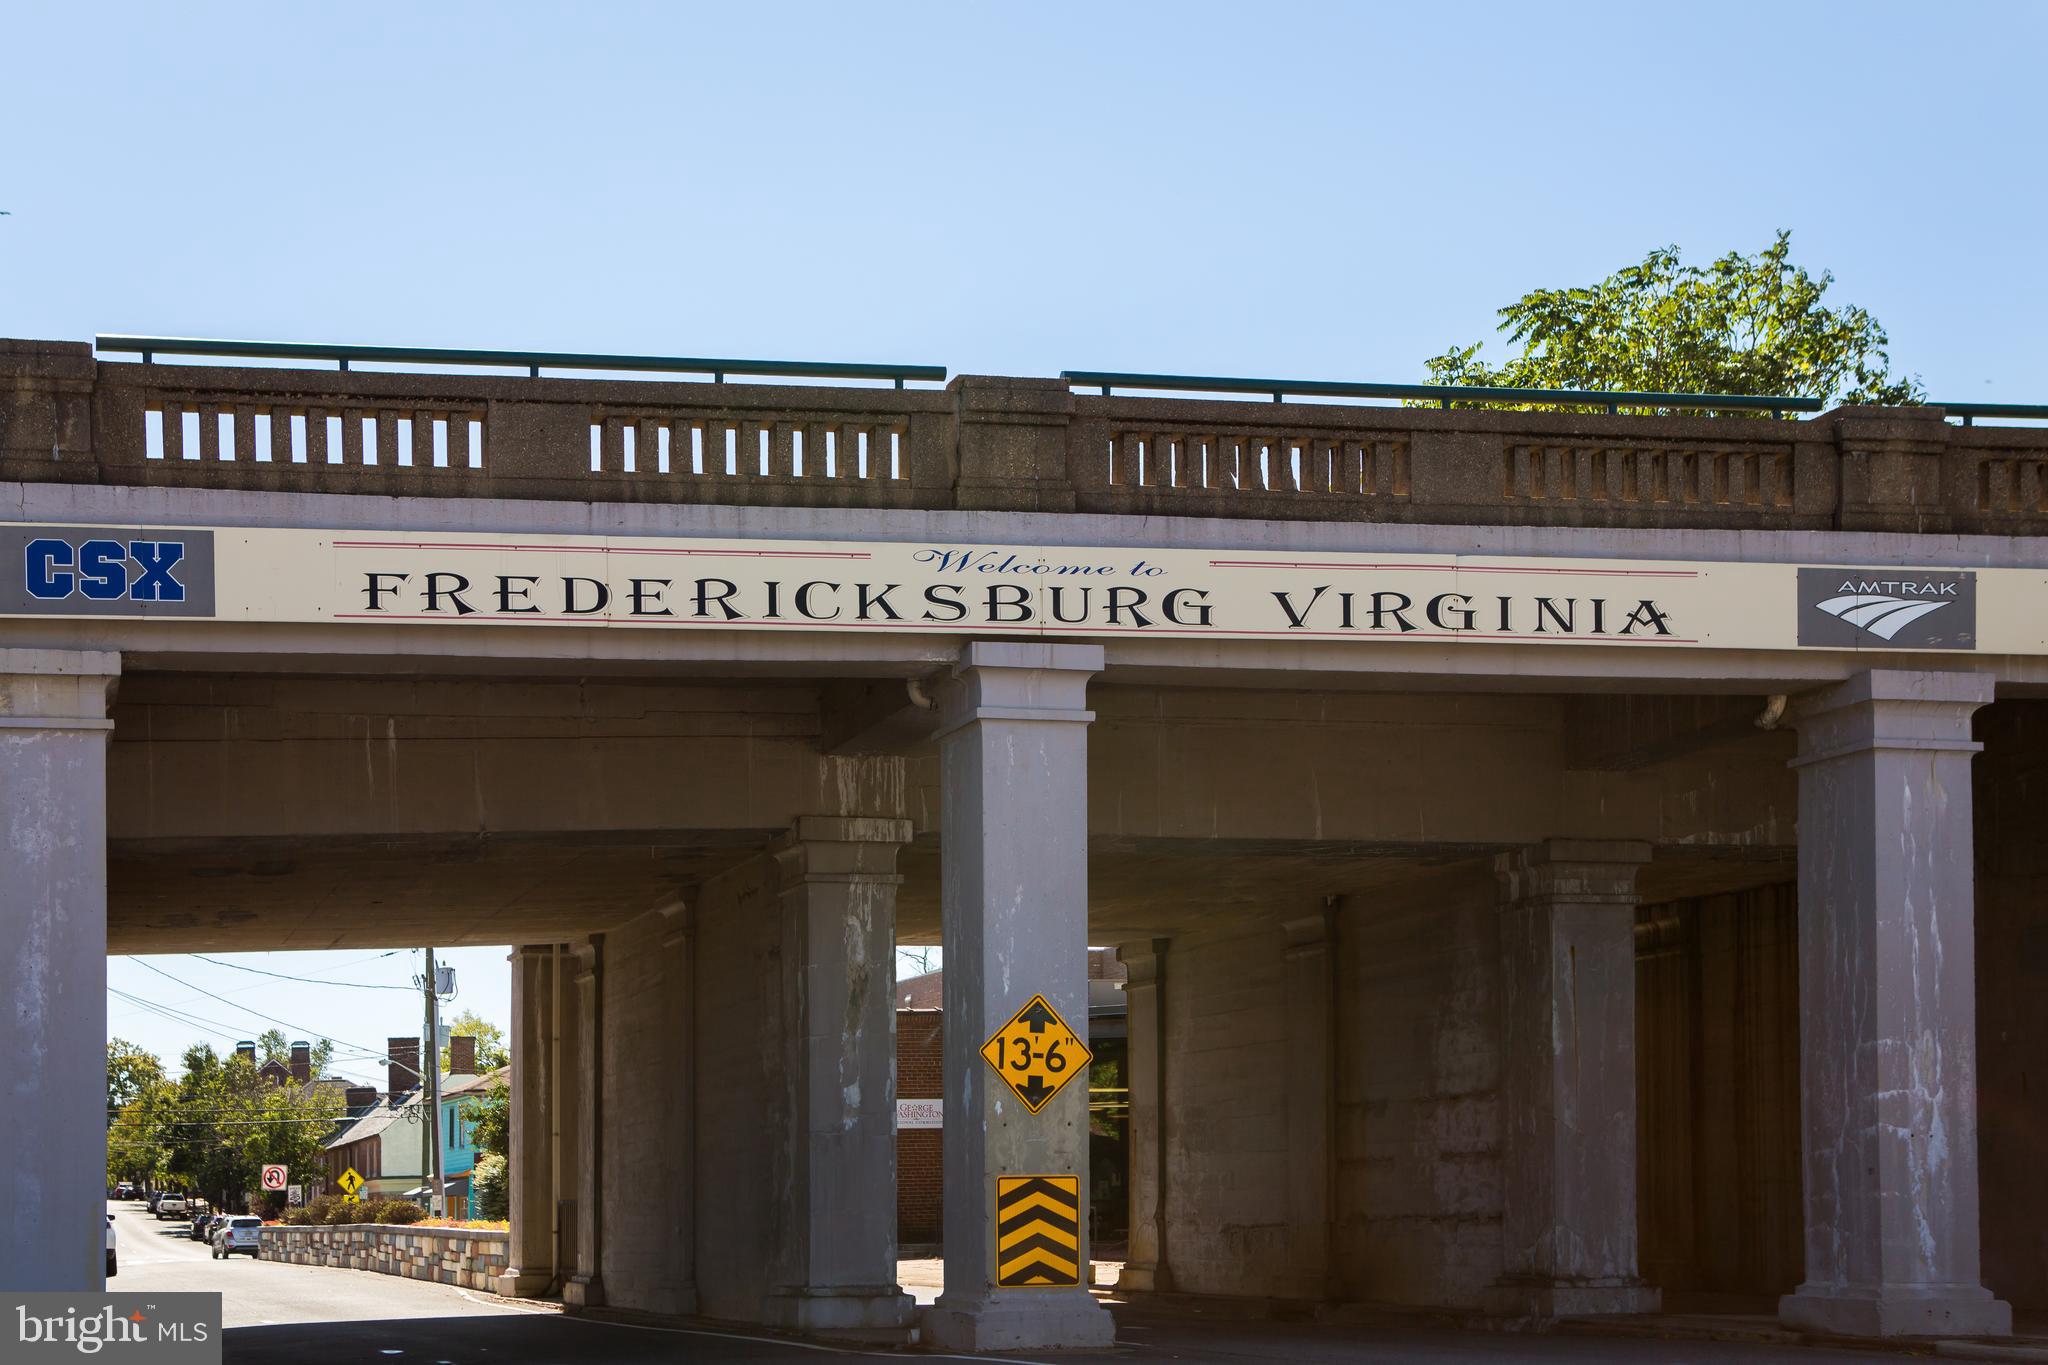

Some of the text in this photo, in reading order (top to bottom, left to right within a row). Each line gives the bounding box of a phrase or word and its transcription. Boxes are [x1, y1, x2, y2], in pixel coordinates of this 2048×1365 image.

[25, 538, 185, 602] CSX
[912, 549, 1168, 577] Welcome to
[1837, 580, 1960, 596] AMTRAK
[360, 571, 1677, 636] FREDERICKSBURG VIRGINIA
[897, 1110, 943, 1119] ASHINGTON
